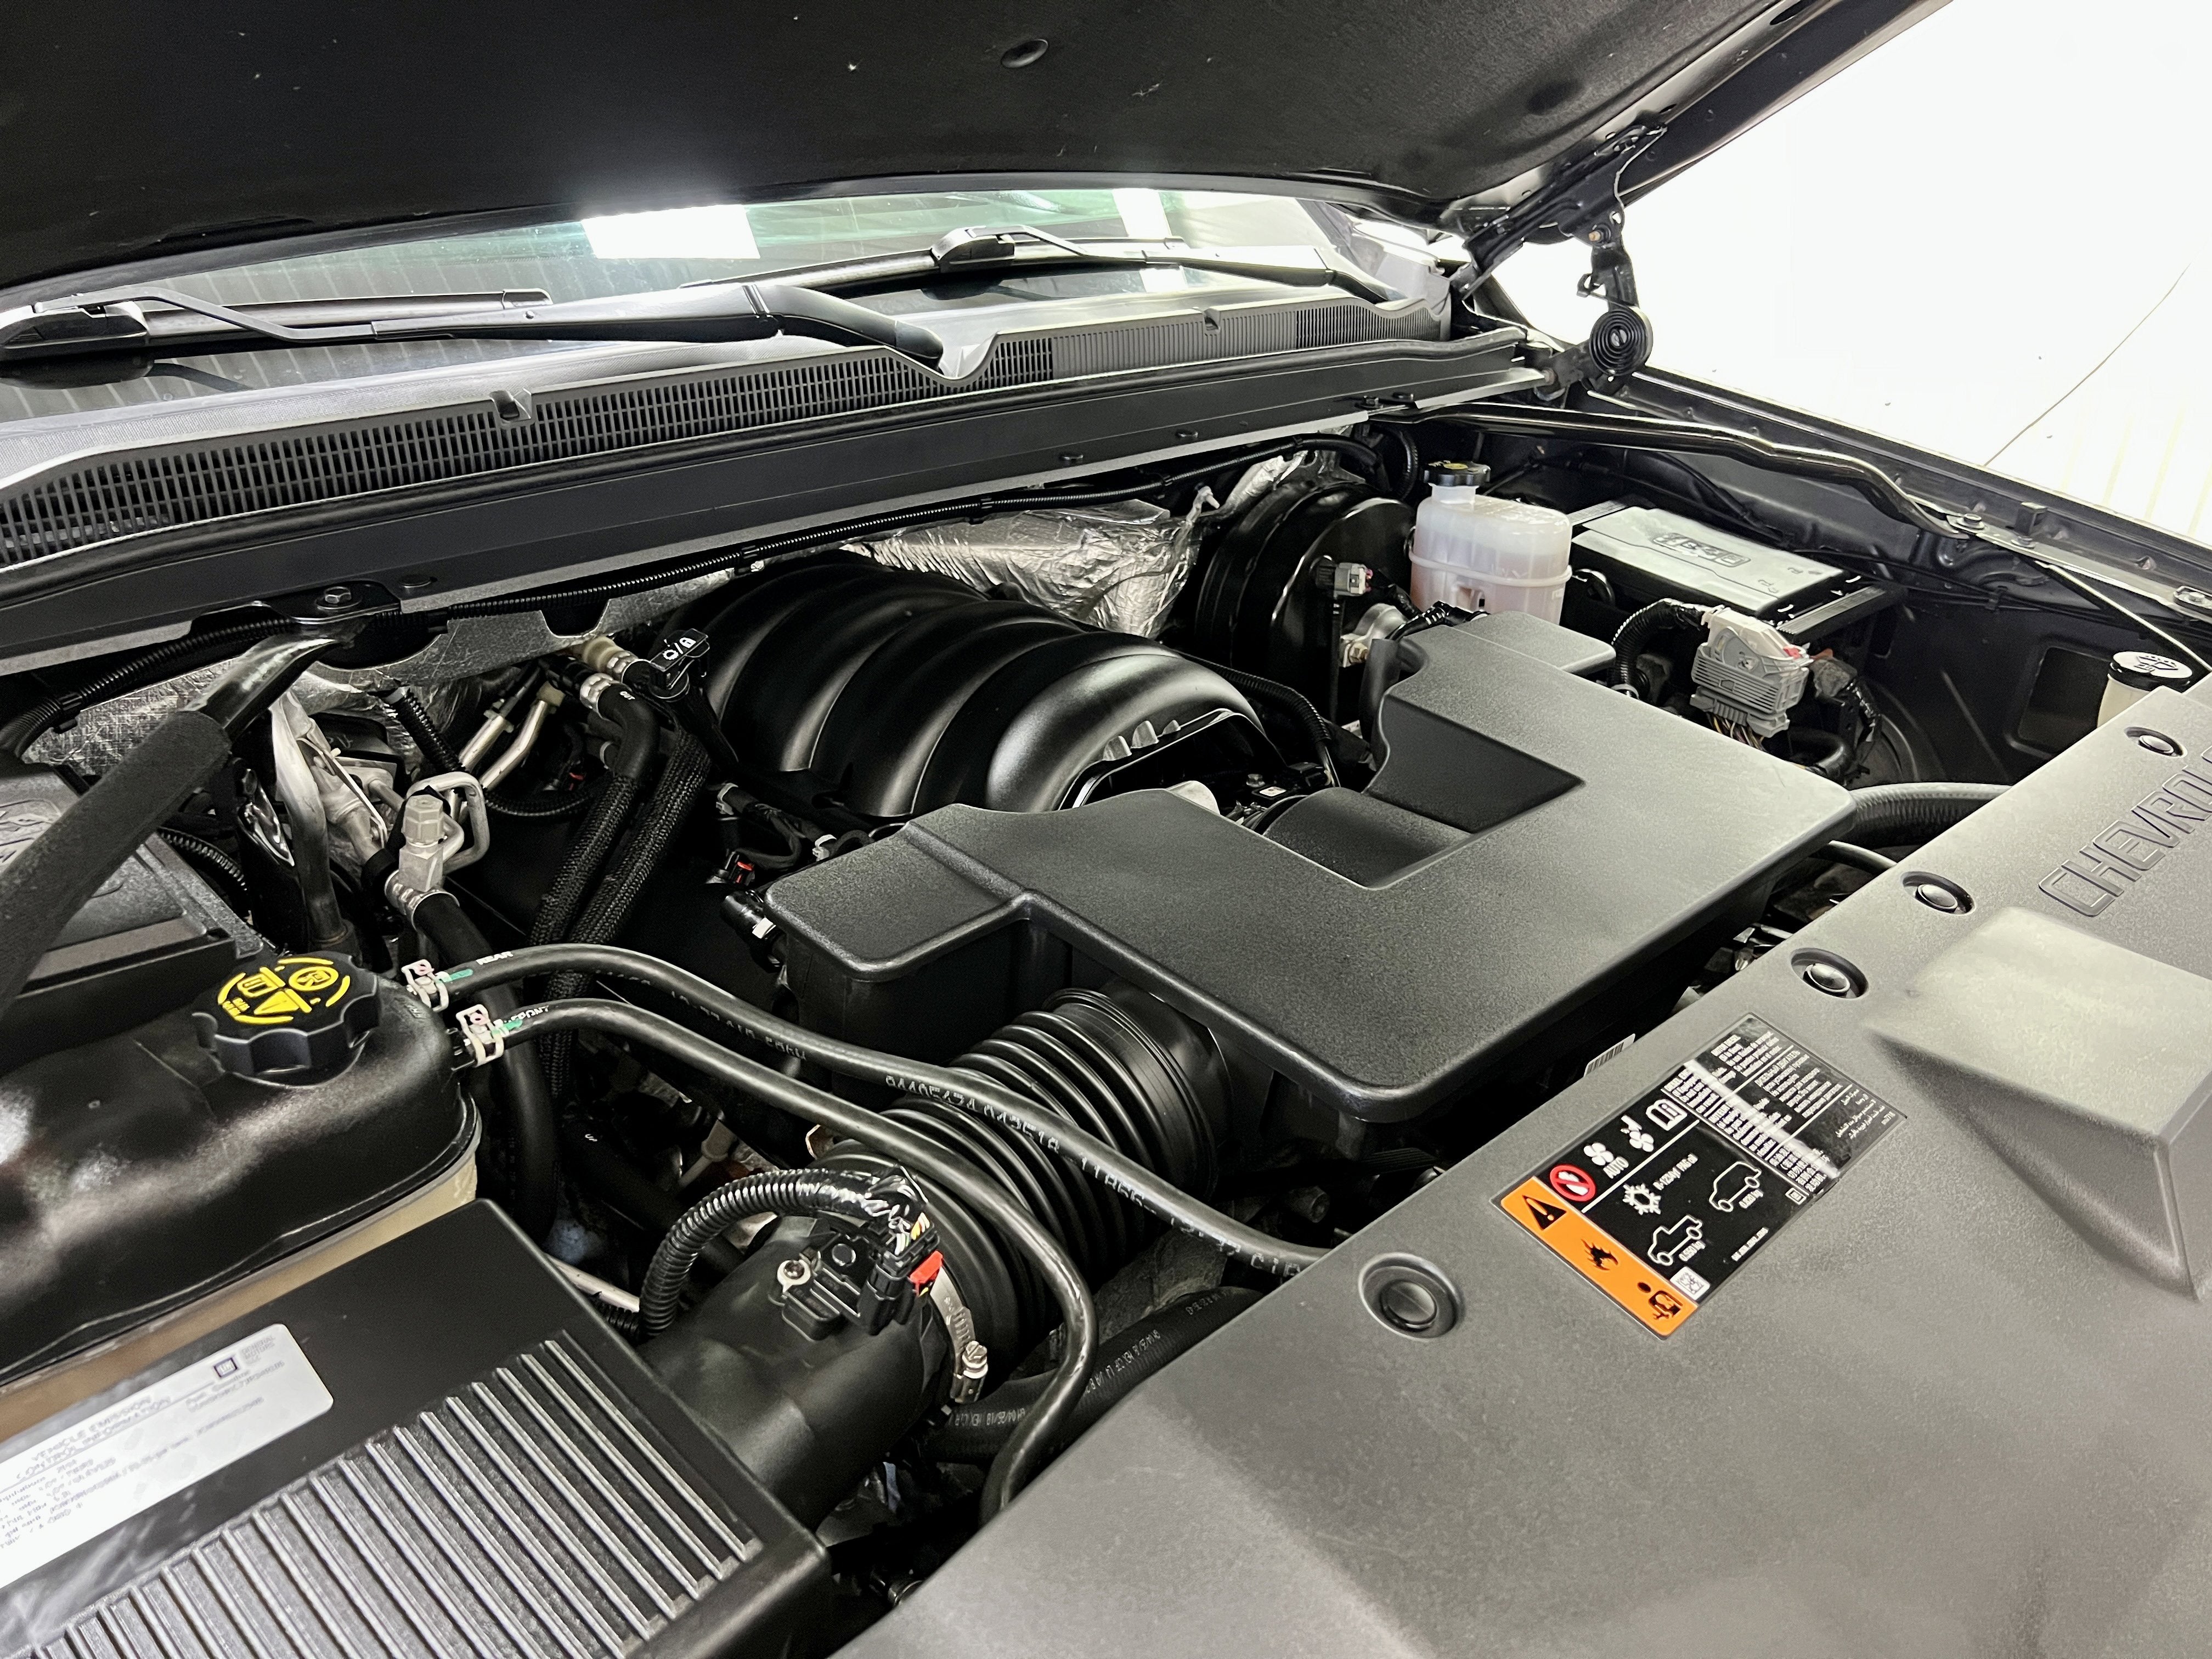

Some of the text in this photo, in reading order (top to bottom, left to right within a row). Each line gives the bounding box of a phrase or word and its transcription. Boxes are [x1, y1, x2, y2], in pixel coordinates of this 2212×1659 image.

[2038, 745, 2212, 917] CHEVRO
[476, 951, 514, 965] REAR
[1603, 1156, 1628, 1178] AUTO
[1676, 1159, 1691, 1171] PAG
[1750, 1187, 1763, 1198] kg
[1691, 1238, 1705, 1250] kg
